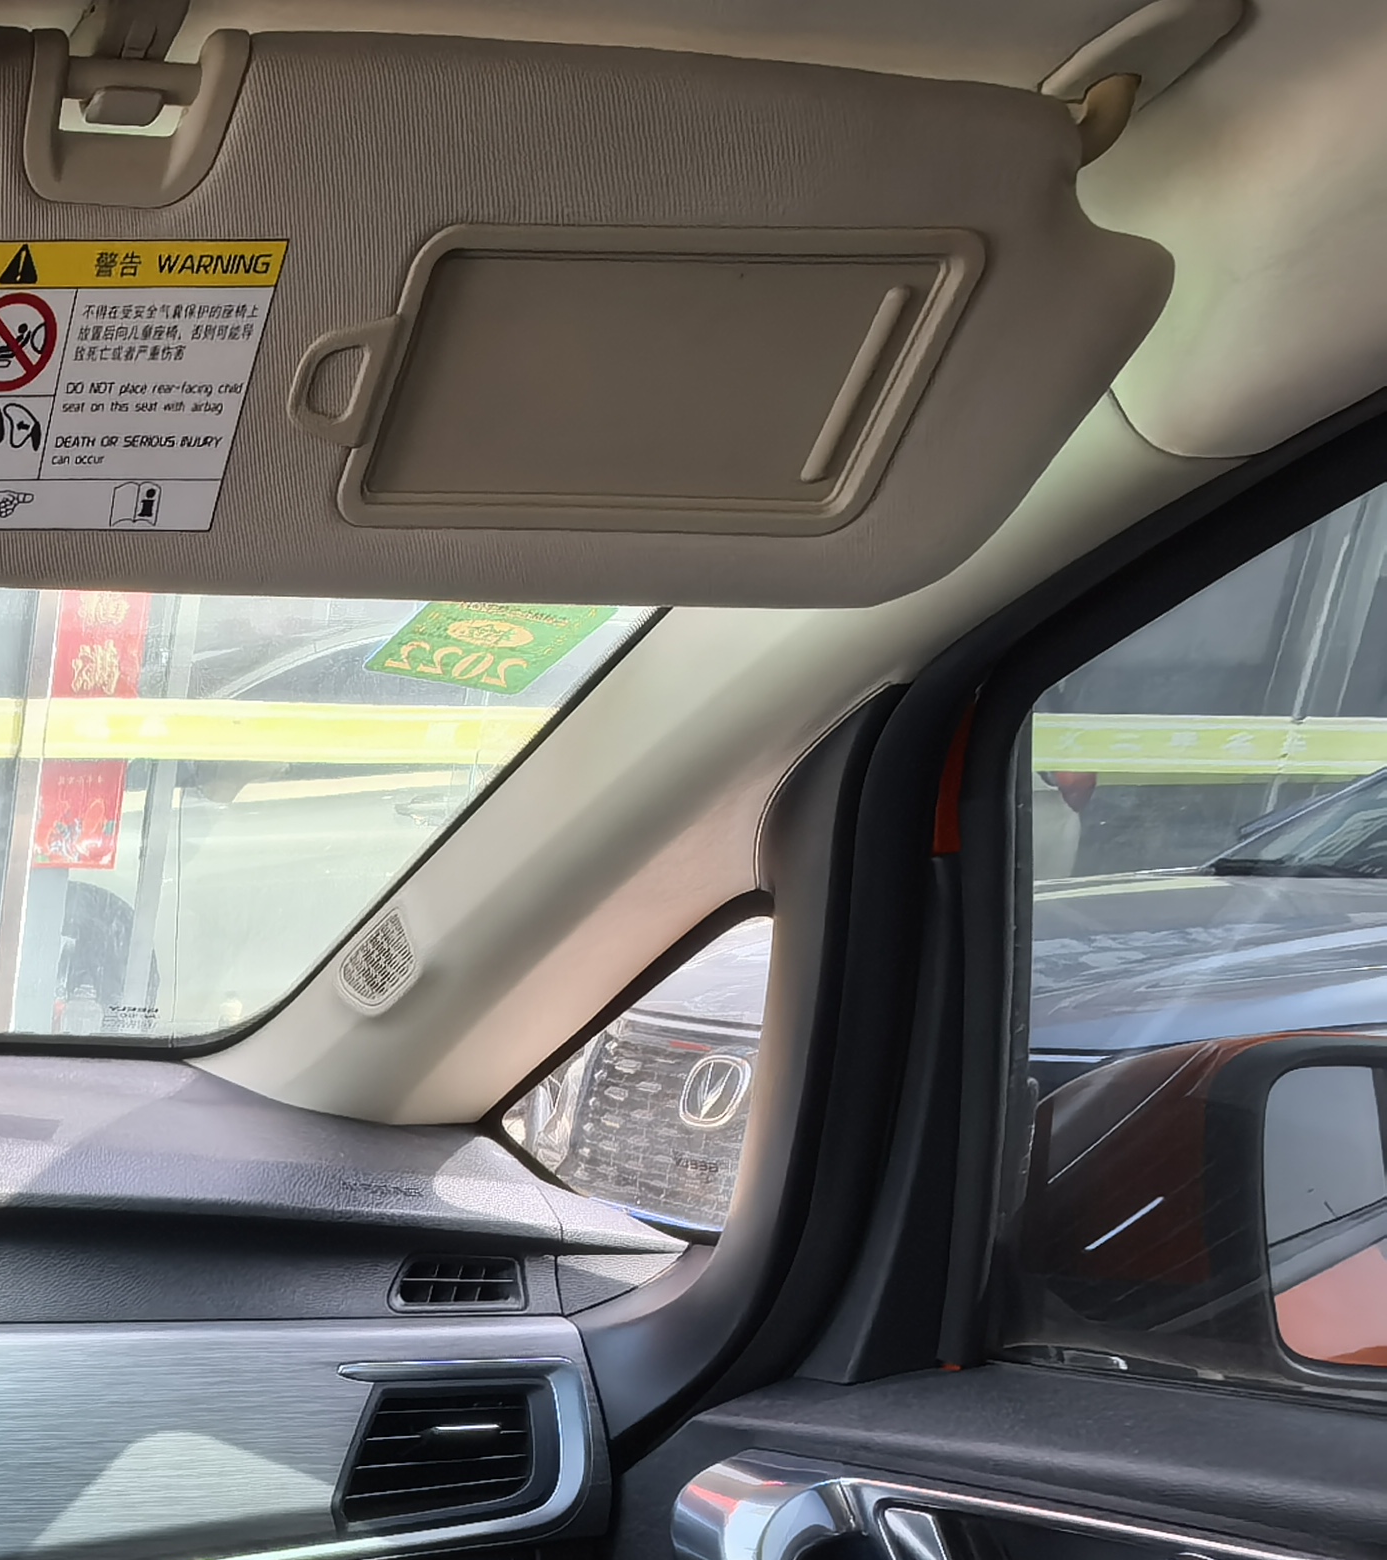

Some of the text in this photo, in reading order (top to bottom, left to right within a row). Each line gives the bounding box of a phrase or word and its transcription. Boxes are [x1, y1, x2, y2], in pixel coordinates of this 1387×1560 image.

[95, 252, 273, 277] 警告 WARNING
[65, 382, 244, 397] DO NOT place rear-facing child
[62, 401, 224, 416] seat on this seat with airbag
[55, 436, 224, 448] DEATH OR SERIOUS INJURY
[51, 456, 105, 465] can occur
